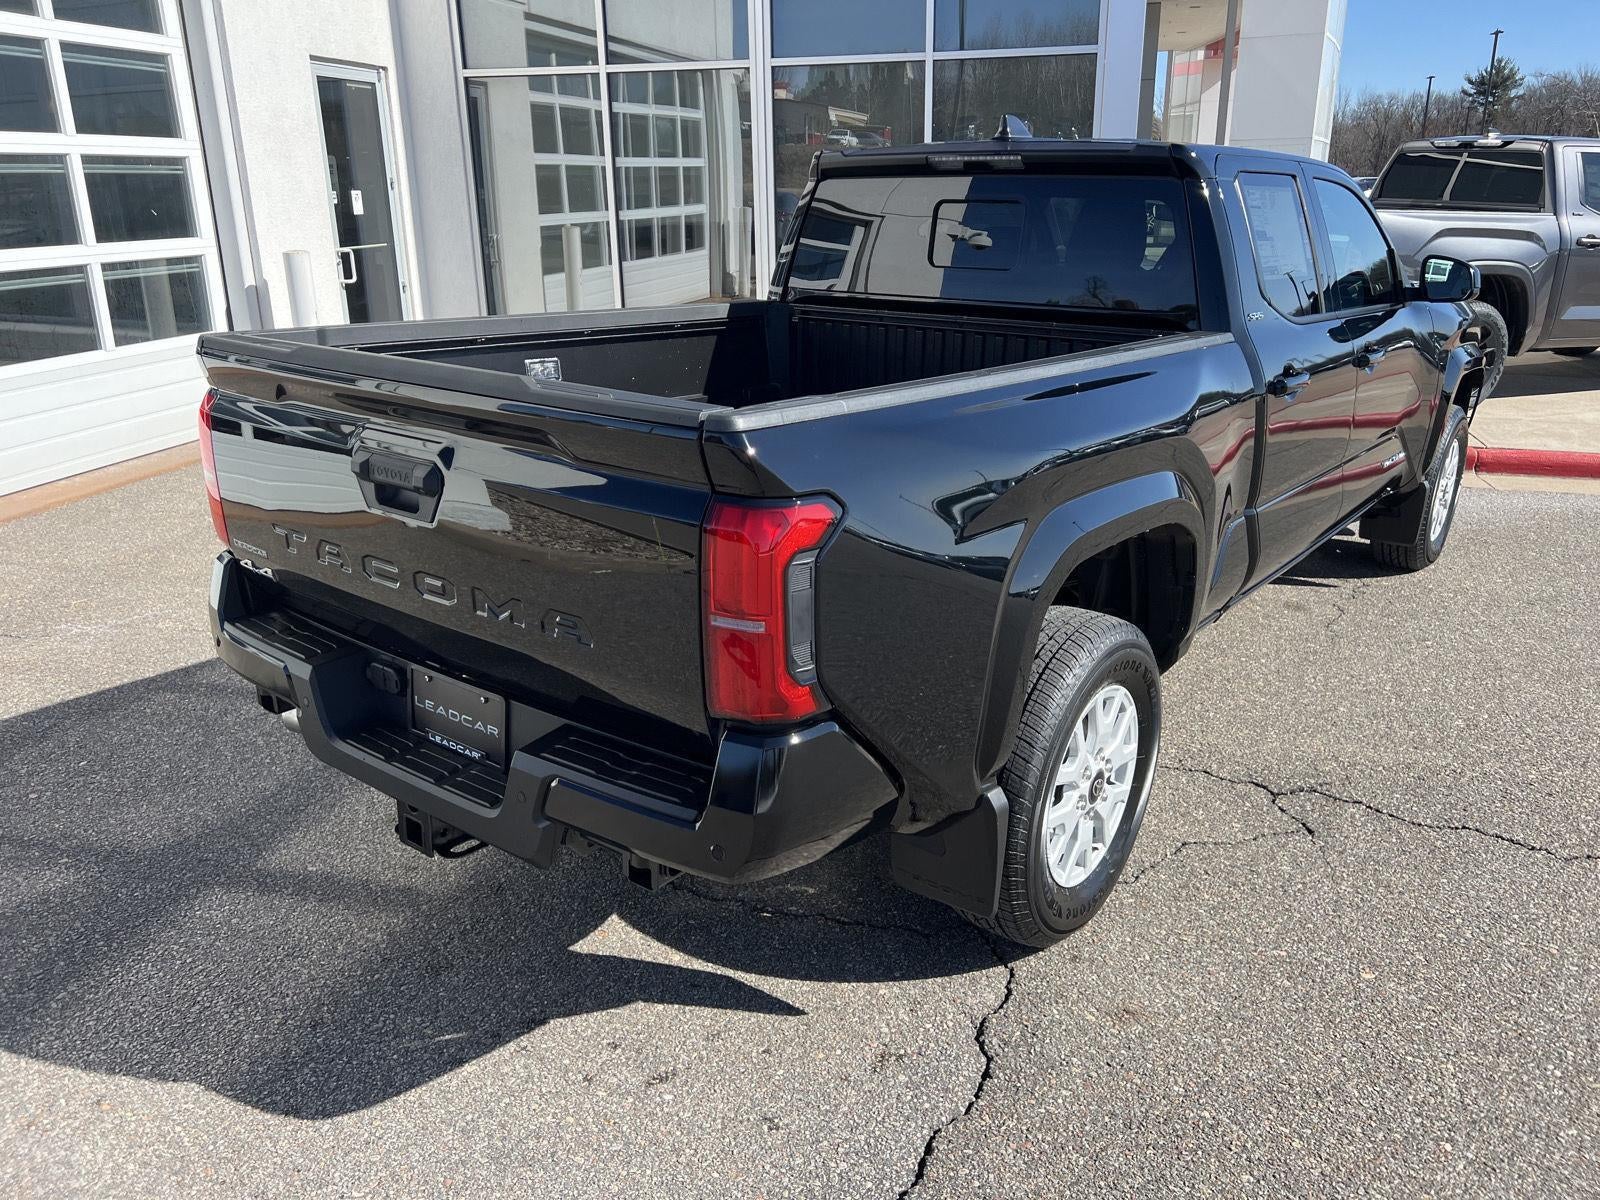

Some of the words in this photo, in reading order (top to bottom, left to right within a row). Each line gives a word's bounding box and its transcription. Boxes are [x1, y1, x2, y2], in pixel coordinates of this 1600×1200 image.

[370, 463, 411, 484] TOYOTA
[271, 523, 594, 648] TACOMA
[415, 695, 499, 738] LEADCAR
[428, 732, 481, 760] LEADCAR
